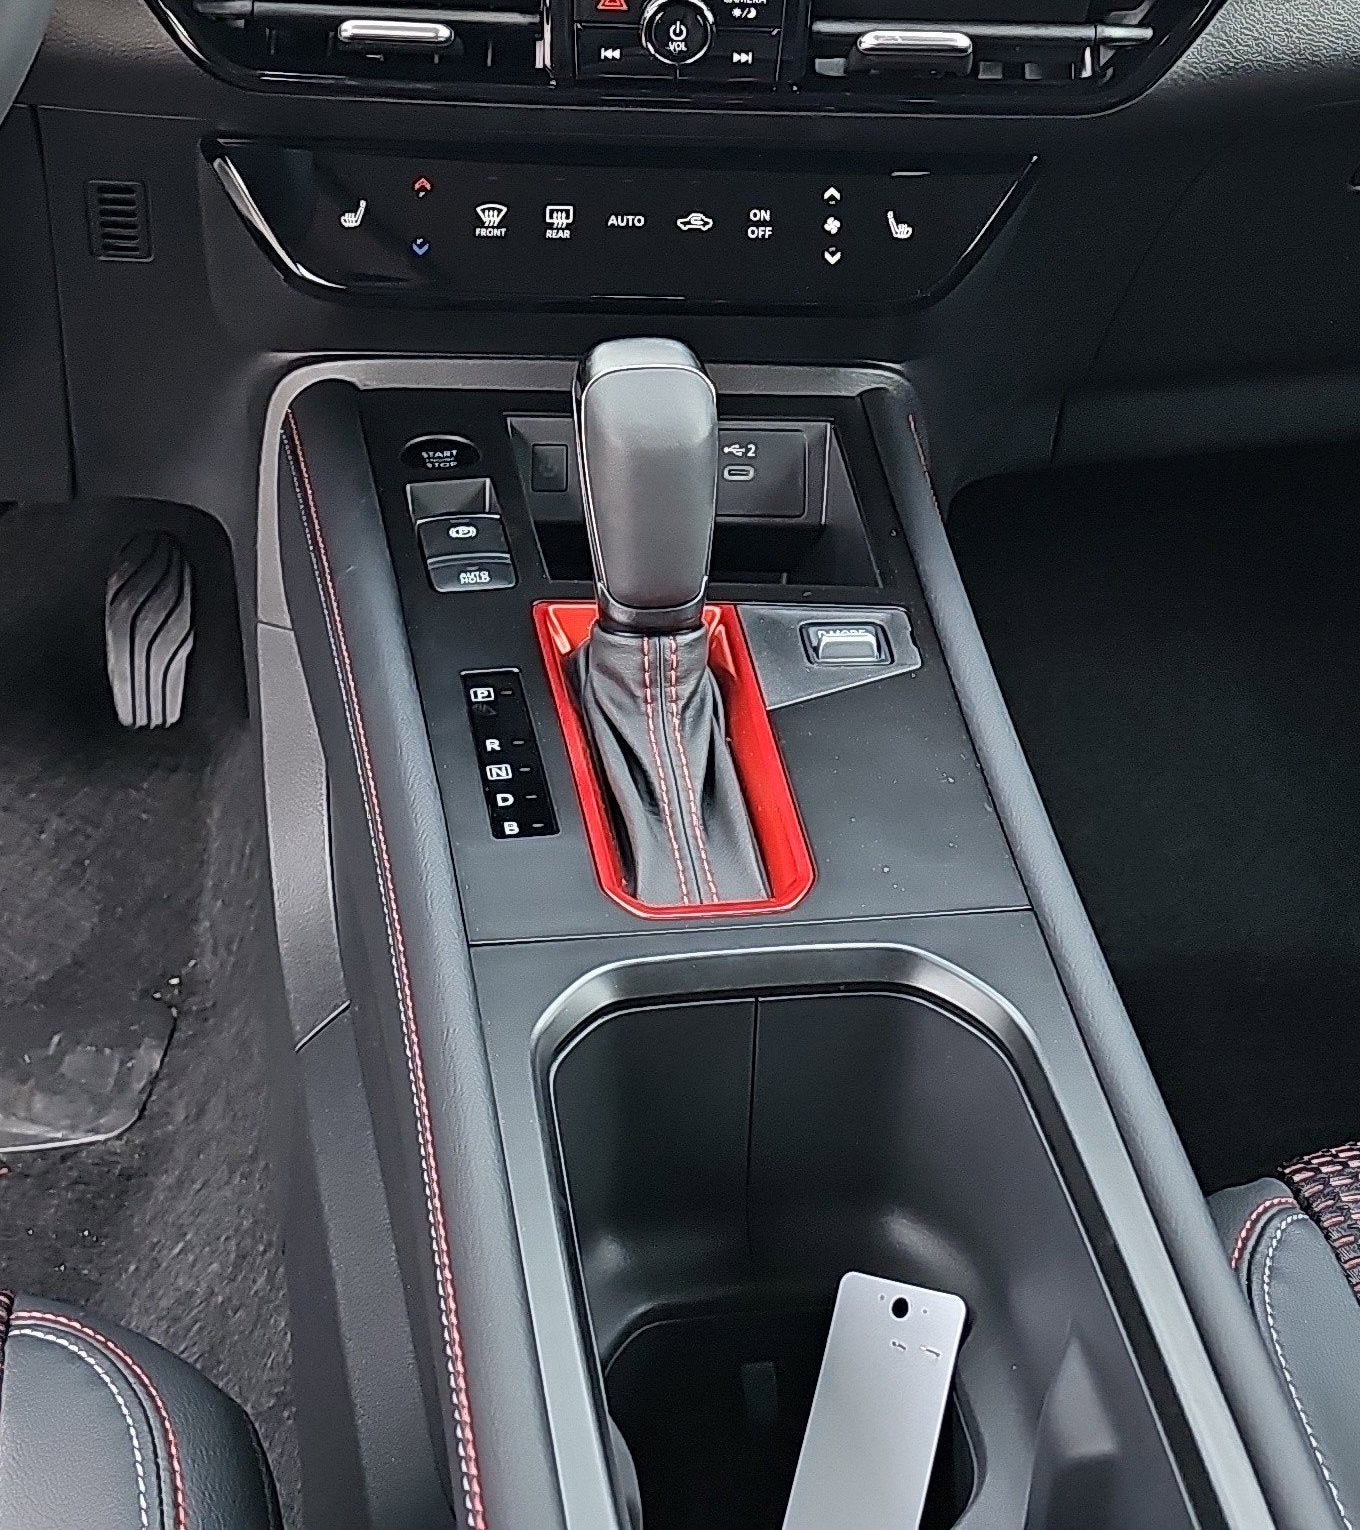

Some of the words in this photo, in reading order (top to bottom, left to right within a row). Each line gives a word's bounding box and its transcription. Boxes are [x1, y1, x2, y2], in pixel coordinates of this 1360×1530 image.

[669, 41, 688, 52] VOL
[608, 214, 645, 227] AUTO
[749, 209, 771, 221] ON
[475, 228, 507, 237] FRONT
[545, 229, 571, 239] REAR
[747, 227, 773, 239] OFF
[421, 449, 458, 459] START
[747, 444, 756, 457] 2
[485, 739, 501, 751] R
[496, 793, 514, 806] D
[503, 822, 520, 835] B
